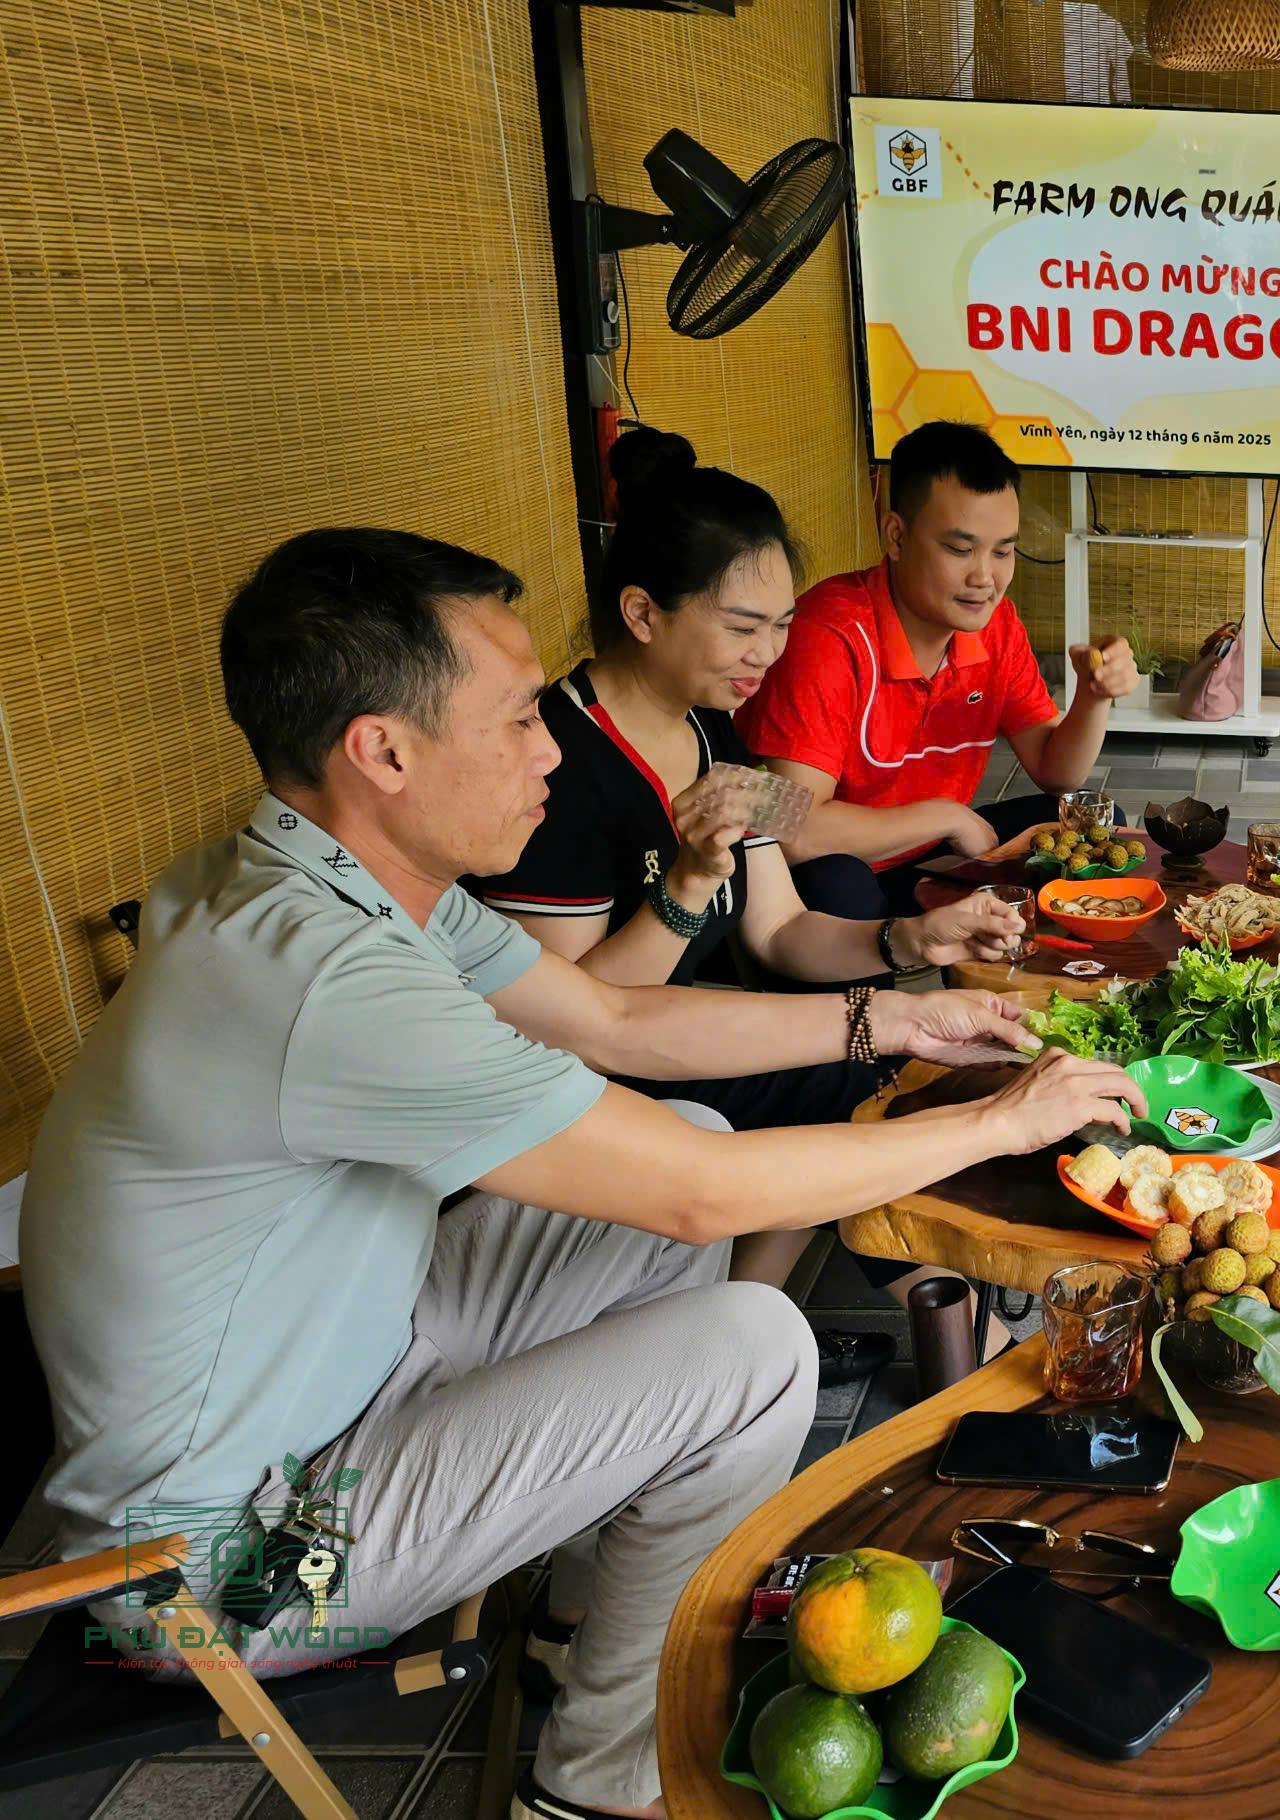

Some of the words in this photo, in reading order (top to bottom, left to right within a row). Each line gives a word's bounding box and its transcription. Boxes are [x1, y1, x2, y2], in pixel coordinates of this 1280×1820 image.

[891, 177, 929, 193] GBF
[992, 179, 1097, 218] FARM
[1109, 186, 1192, 223] ONG
[1038, 250, 1150, 292] CHÀO
[966, 303, 1071, 354] BNI
[1019, 424, 1052, 438] Vĩnh
[1056, 426, 1087, 440] Yên,
[1090, 428, 1125, 442] ngày
[1128, 430, 1143, 441] 12
[1146, 429, 1188, 445] tháng
[1191, 432, 1200, 443] 6
[1203, 431, 1234, 444] năm
[1237, 433, 1271, 445] 2025
